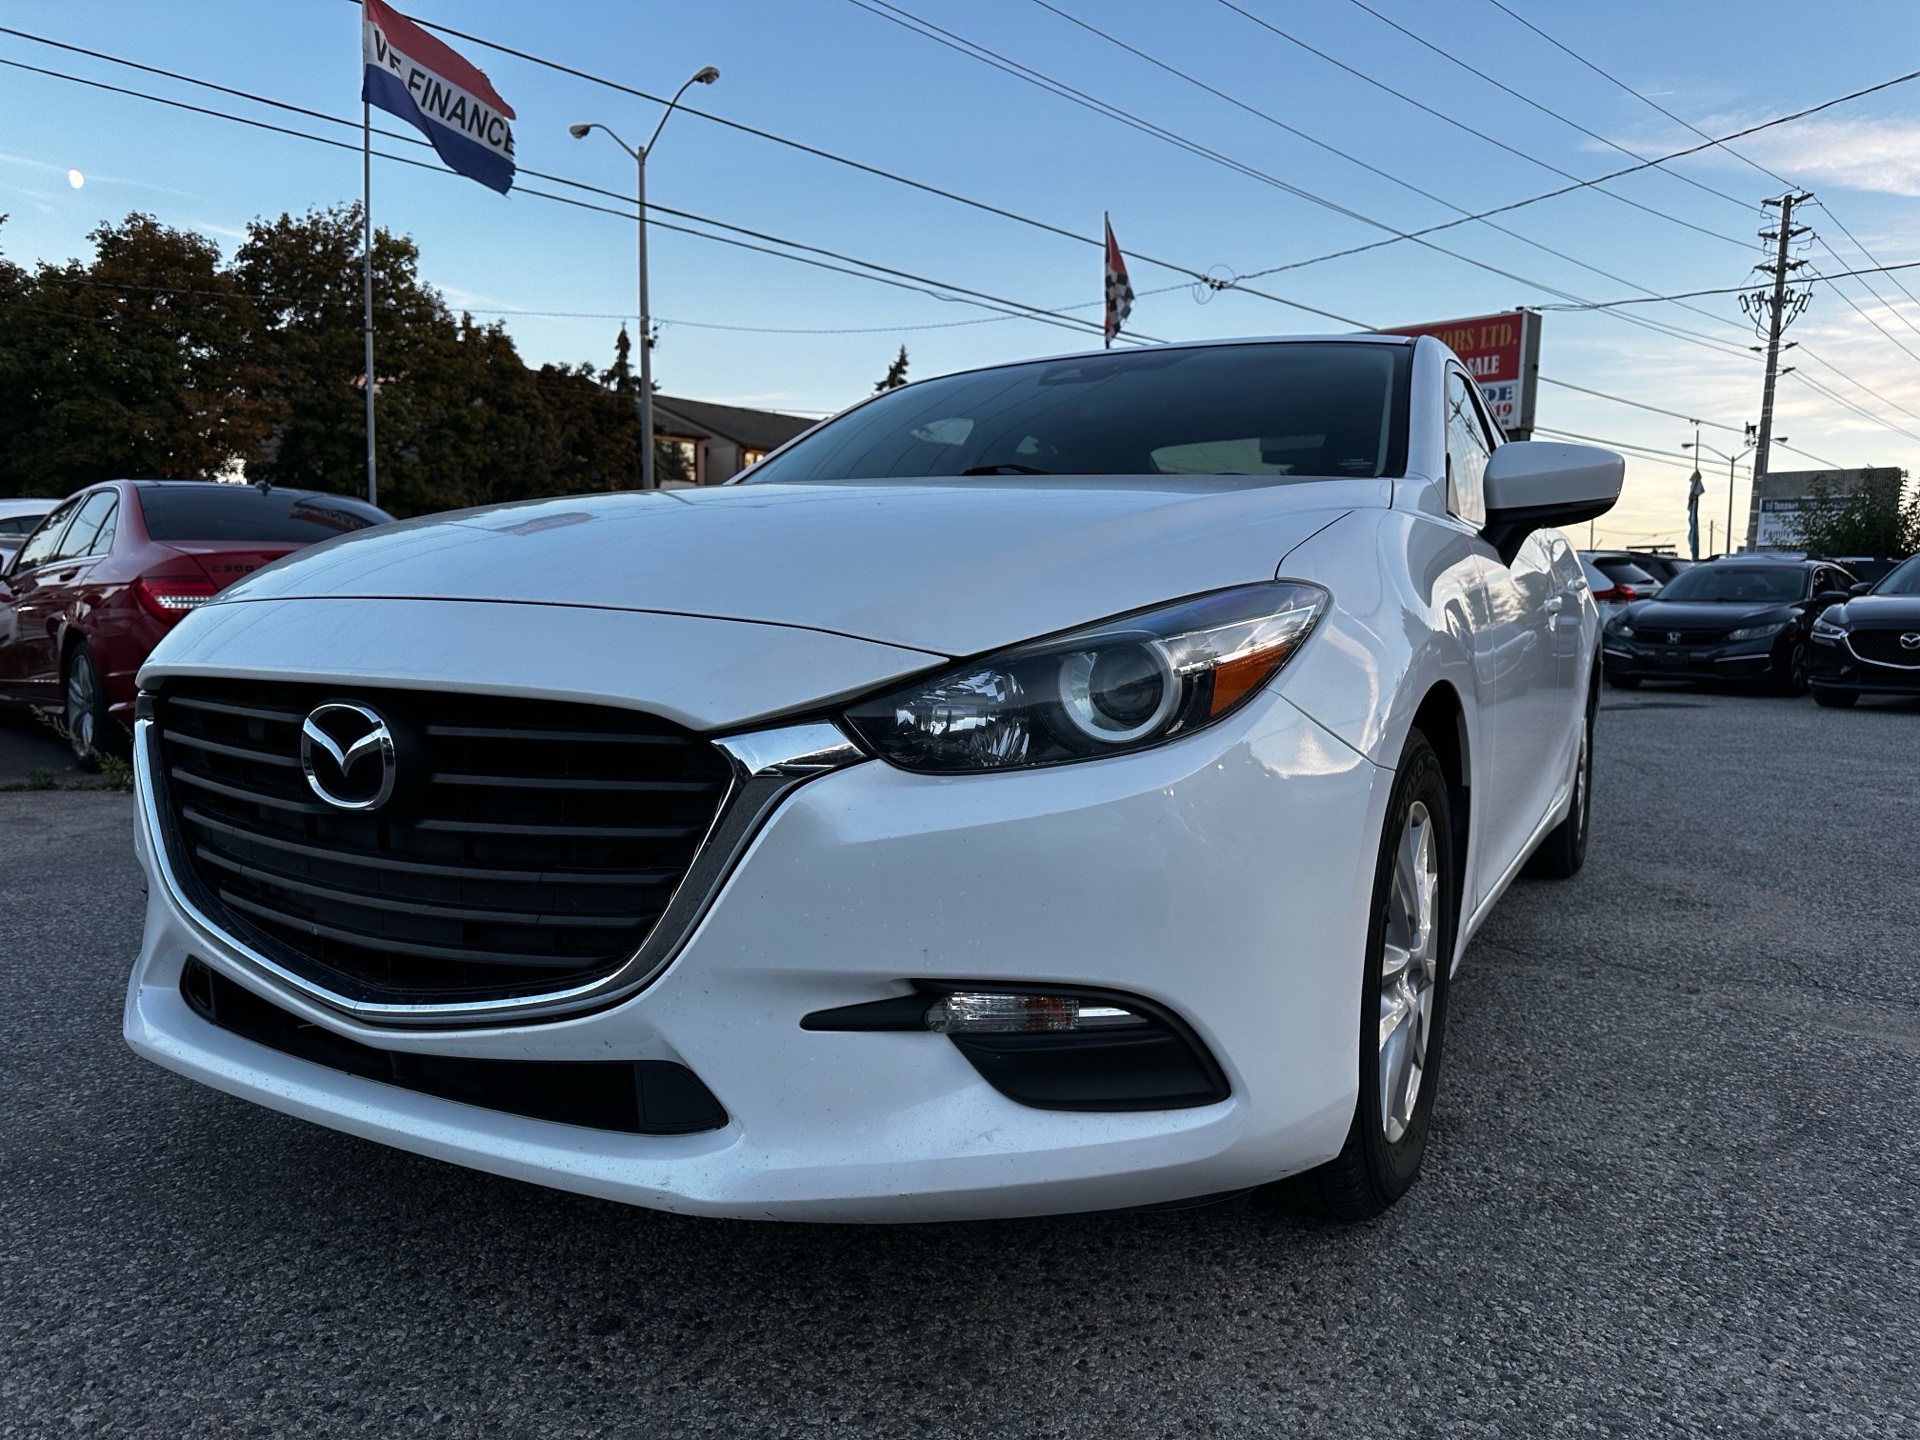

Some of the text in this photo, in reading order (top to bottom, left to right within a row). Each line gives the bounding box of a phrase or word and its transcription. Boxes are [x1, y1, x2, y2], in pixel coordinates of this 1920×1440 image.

[408, 67, 516, 156] FINANCE
[1480, 323, 1517, 349] LTD.
[1466, 354, 1500, 376] SALE
[1398, 758, 1424, 823] TOYO
